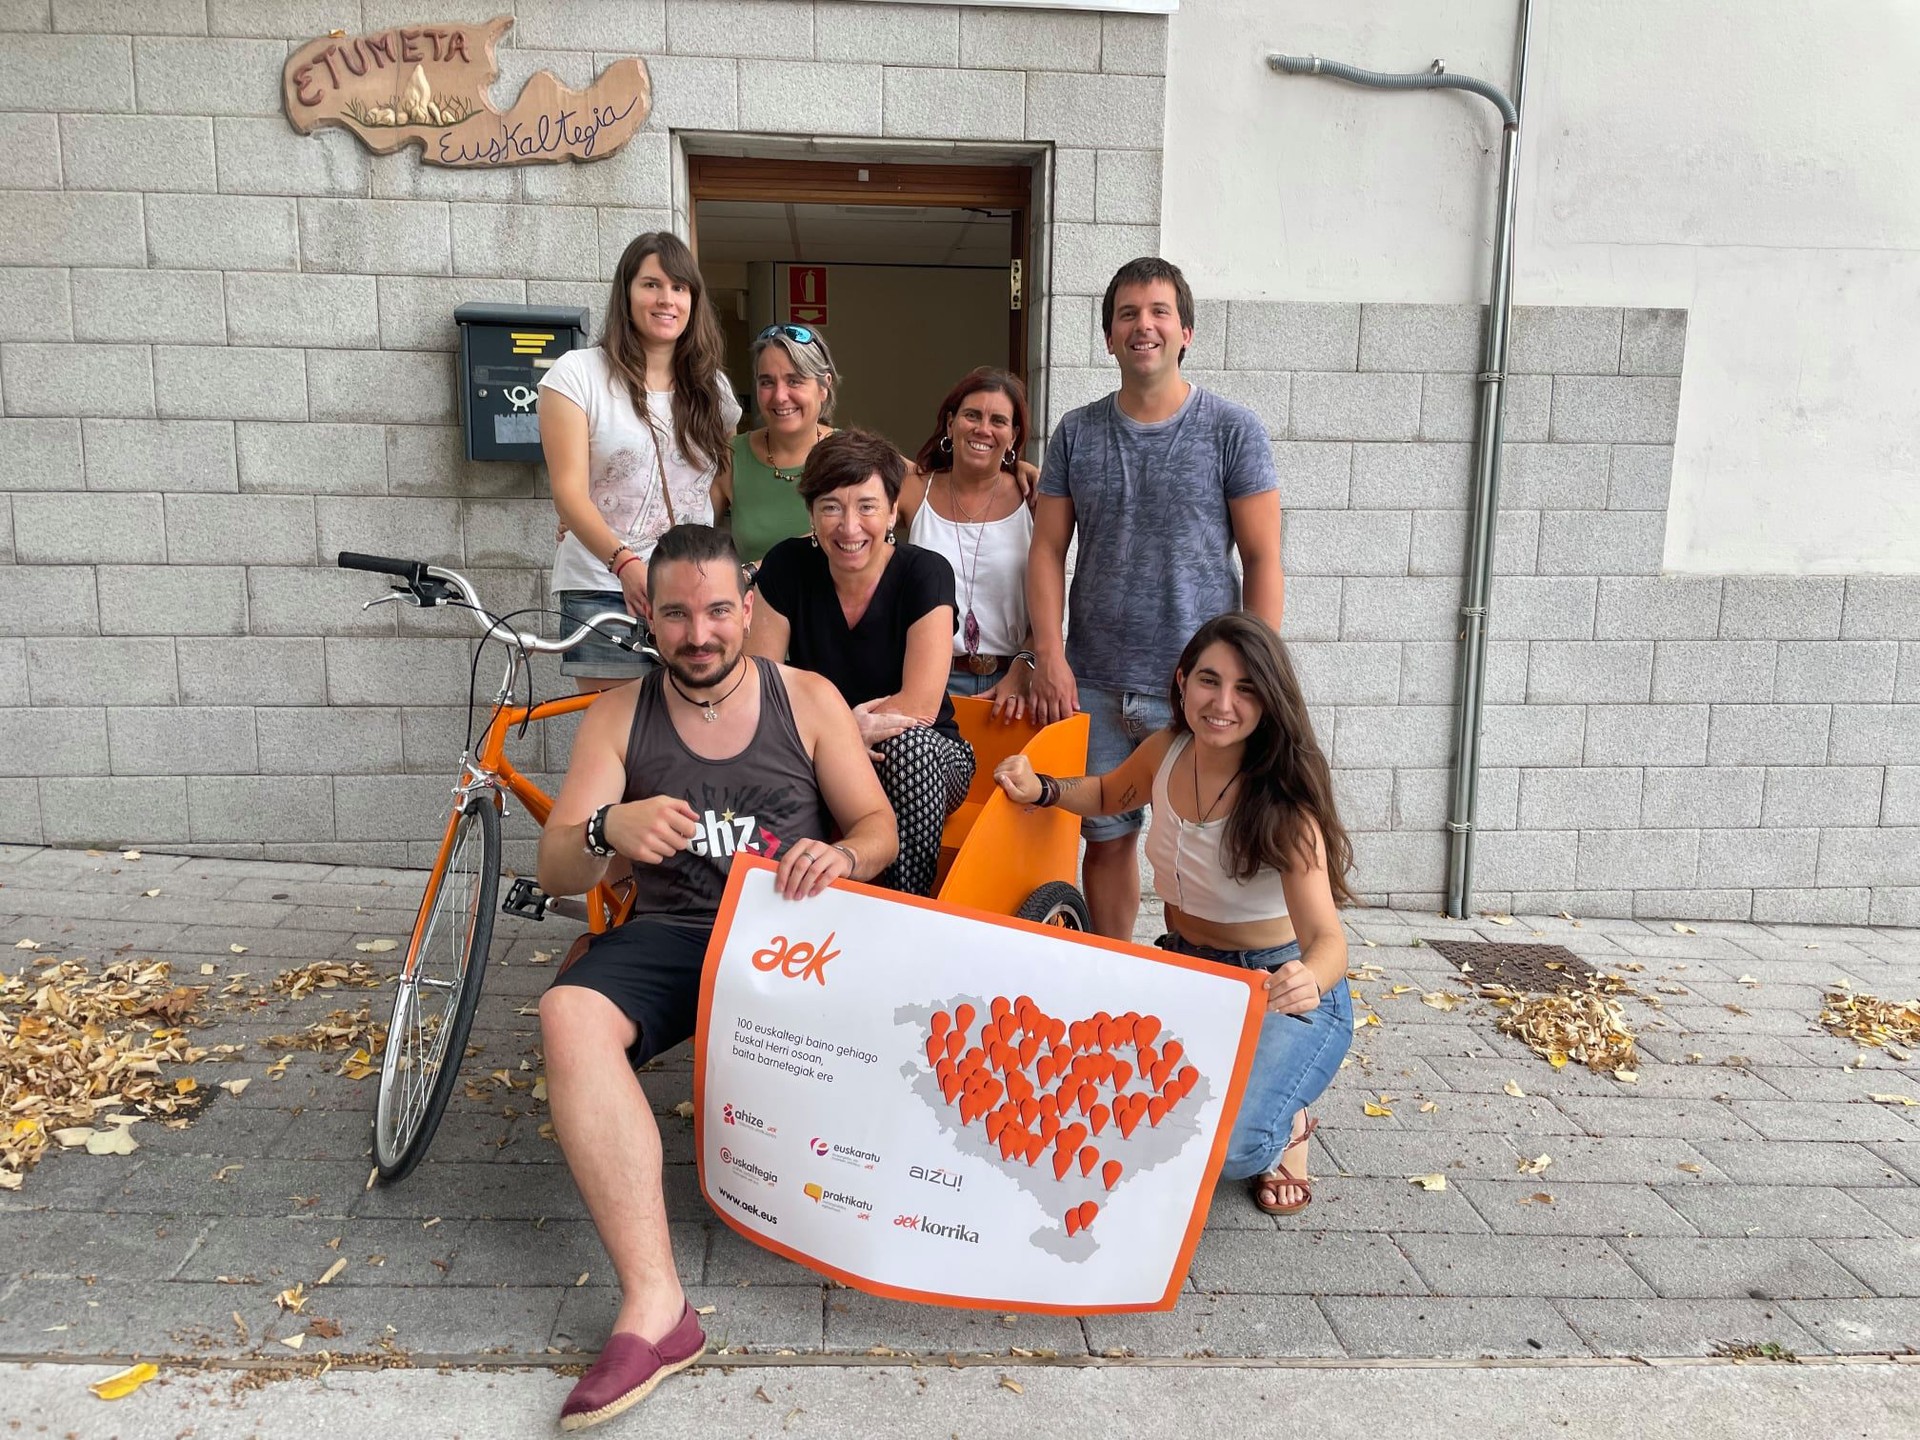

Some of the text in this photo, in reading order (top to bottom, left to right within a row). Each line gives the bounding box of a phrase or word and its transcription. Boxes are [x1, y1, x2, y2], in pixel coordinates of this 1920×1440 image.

[293, 29, 470, 106] ETUMETA
[440, 97, 638, 164] Euskaltegia
[751, 931, 842, 986] aek
[734, 1031, 825, 1067] Euskal Herri osoan,
[737, 1017, 879, 1064] 100 euskaltegi baino gehiago
[732, 1044, 834, 1083] baita barnetegiak ere
[734, 1109, 764, 1129] ahize
[833, 1143, 881, 1164] euskaratu
[718, 1186, 778, 1225] www.aek.eus
[822, 1190, 874, 1213] praktikatu
[893, 1213, 980, 1244] aek korrika
